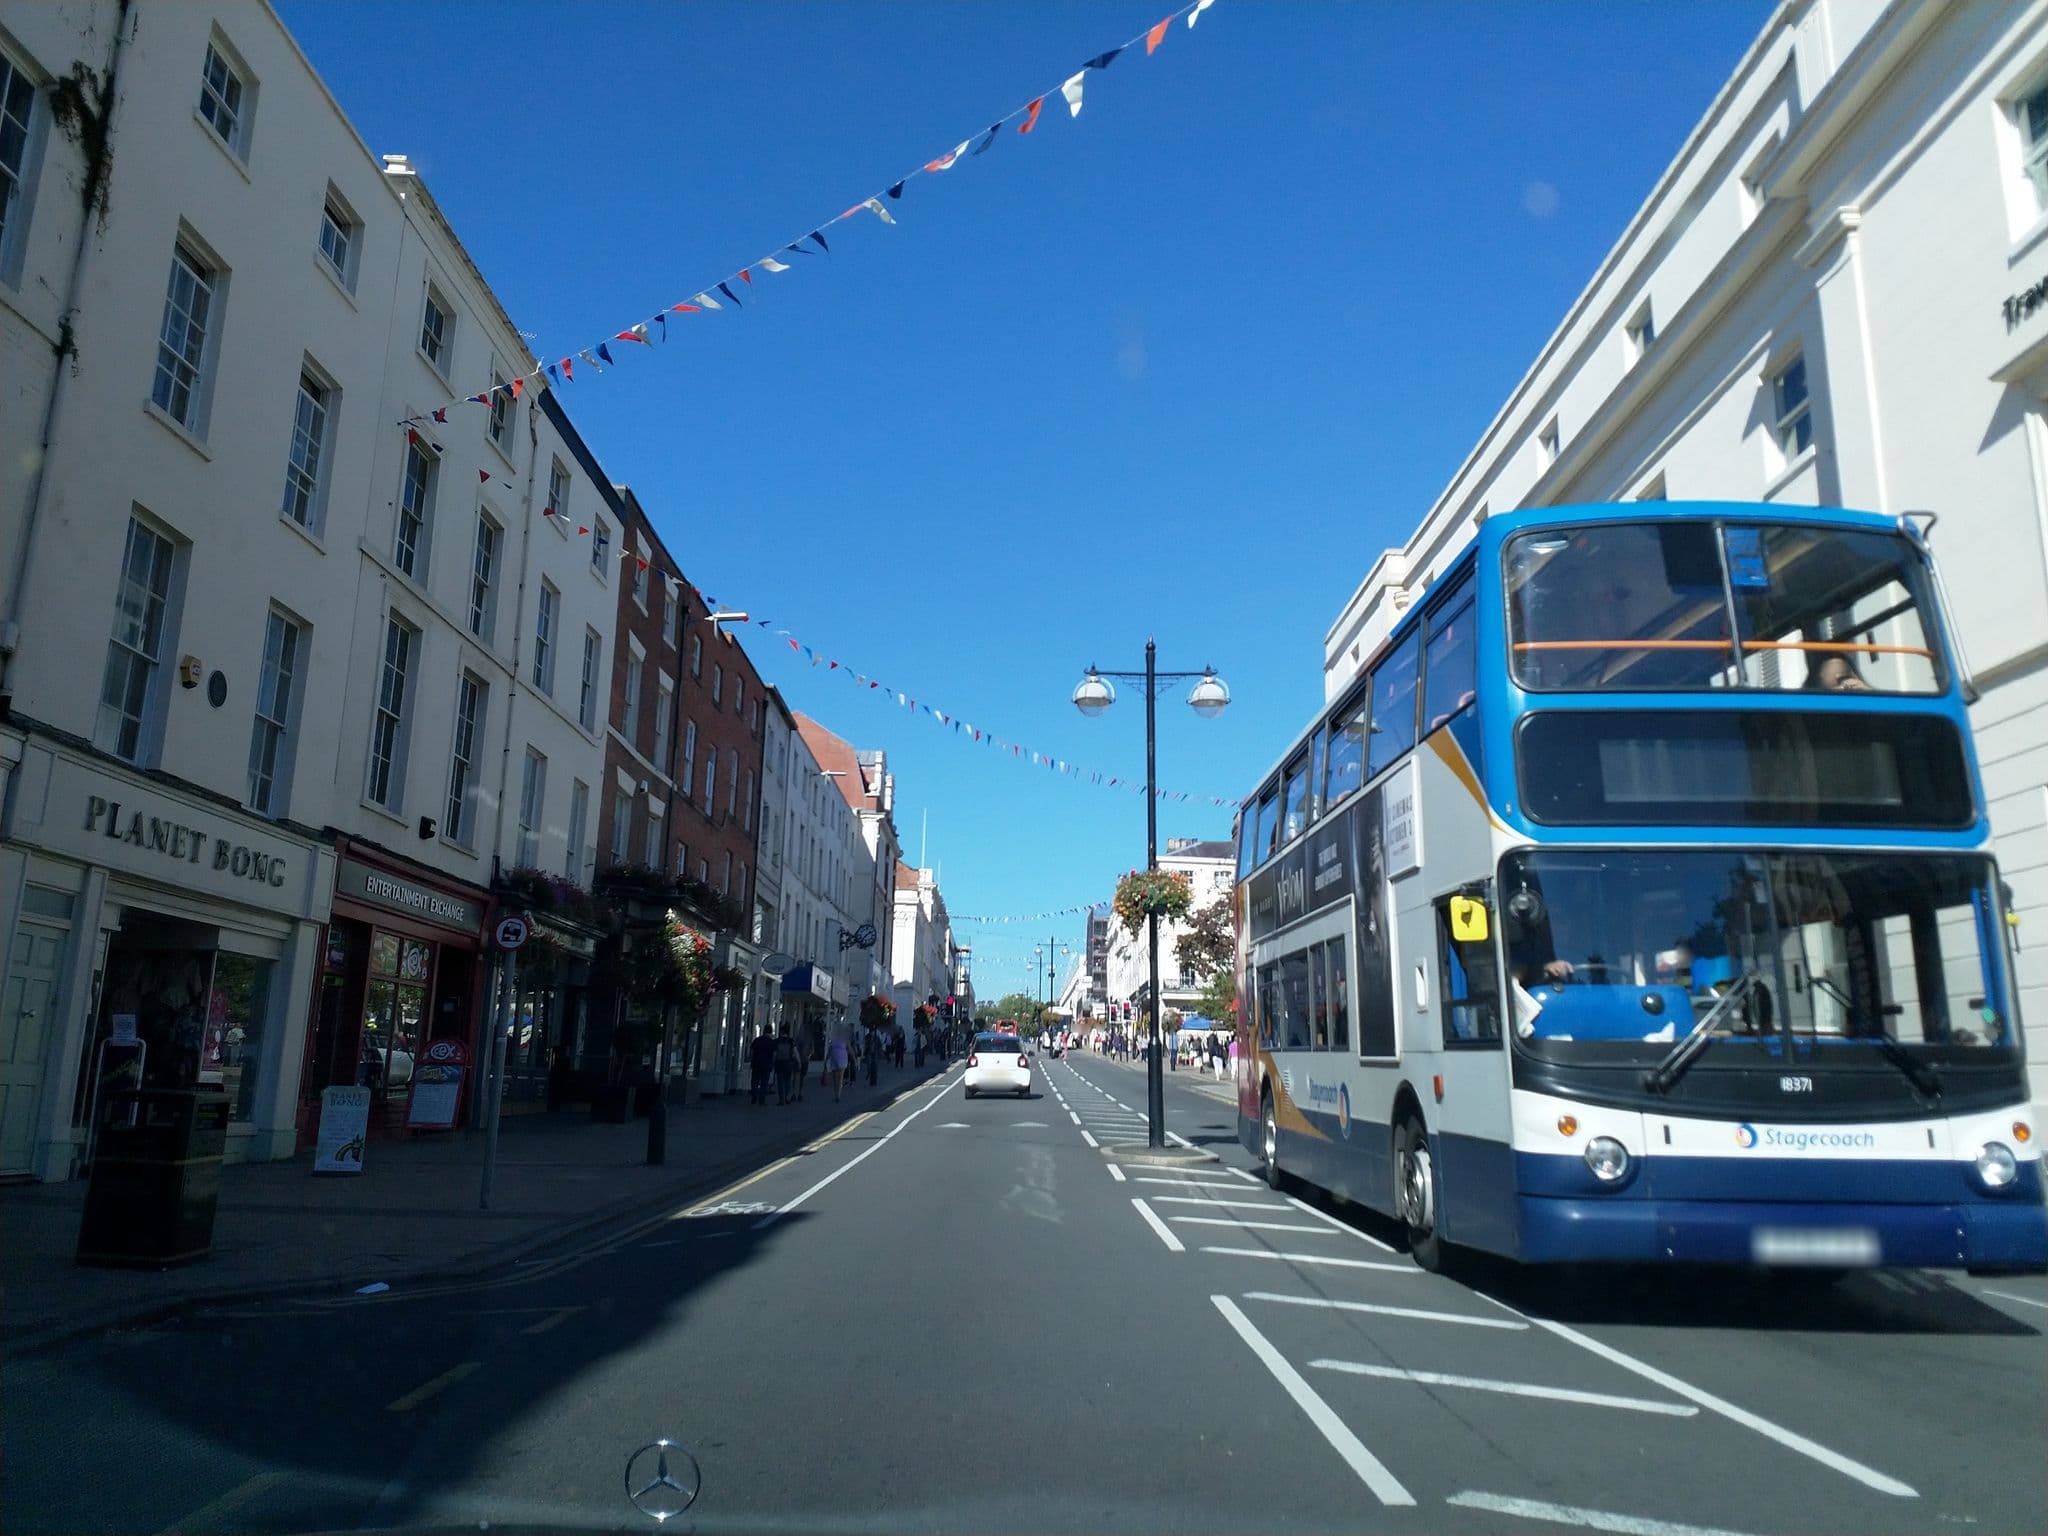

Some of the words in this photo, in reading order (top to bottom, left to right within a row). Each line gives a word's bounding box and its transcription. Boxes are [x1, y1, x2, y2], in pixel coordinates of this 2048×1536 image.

[84, 795, 207, 864] PLANET
[212, 838, 286, 888] BONG
[366, 875, 428, 910] ENTERTAINMENT
[429, 897, 465, 922] EXCHANGE
[1780, 1076, 1813, 1093] 18371
[1765, 1128, 1875, 1150] Stagecoach
